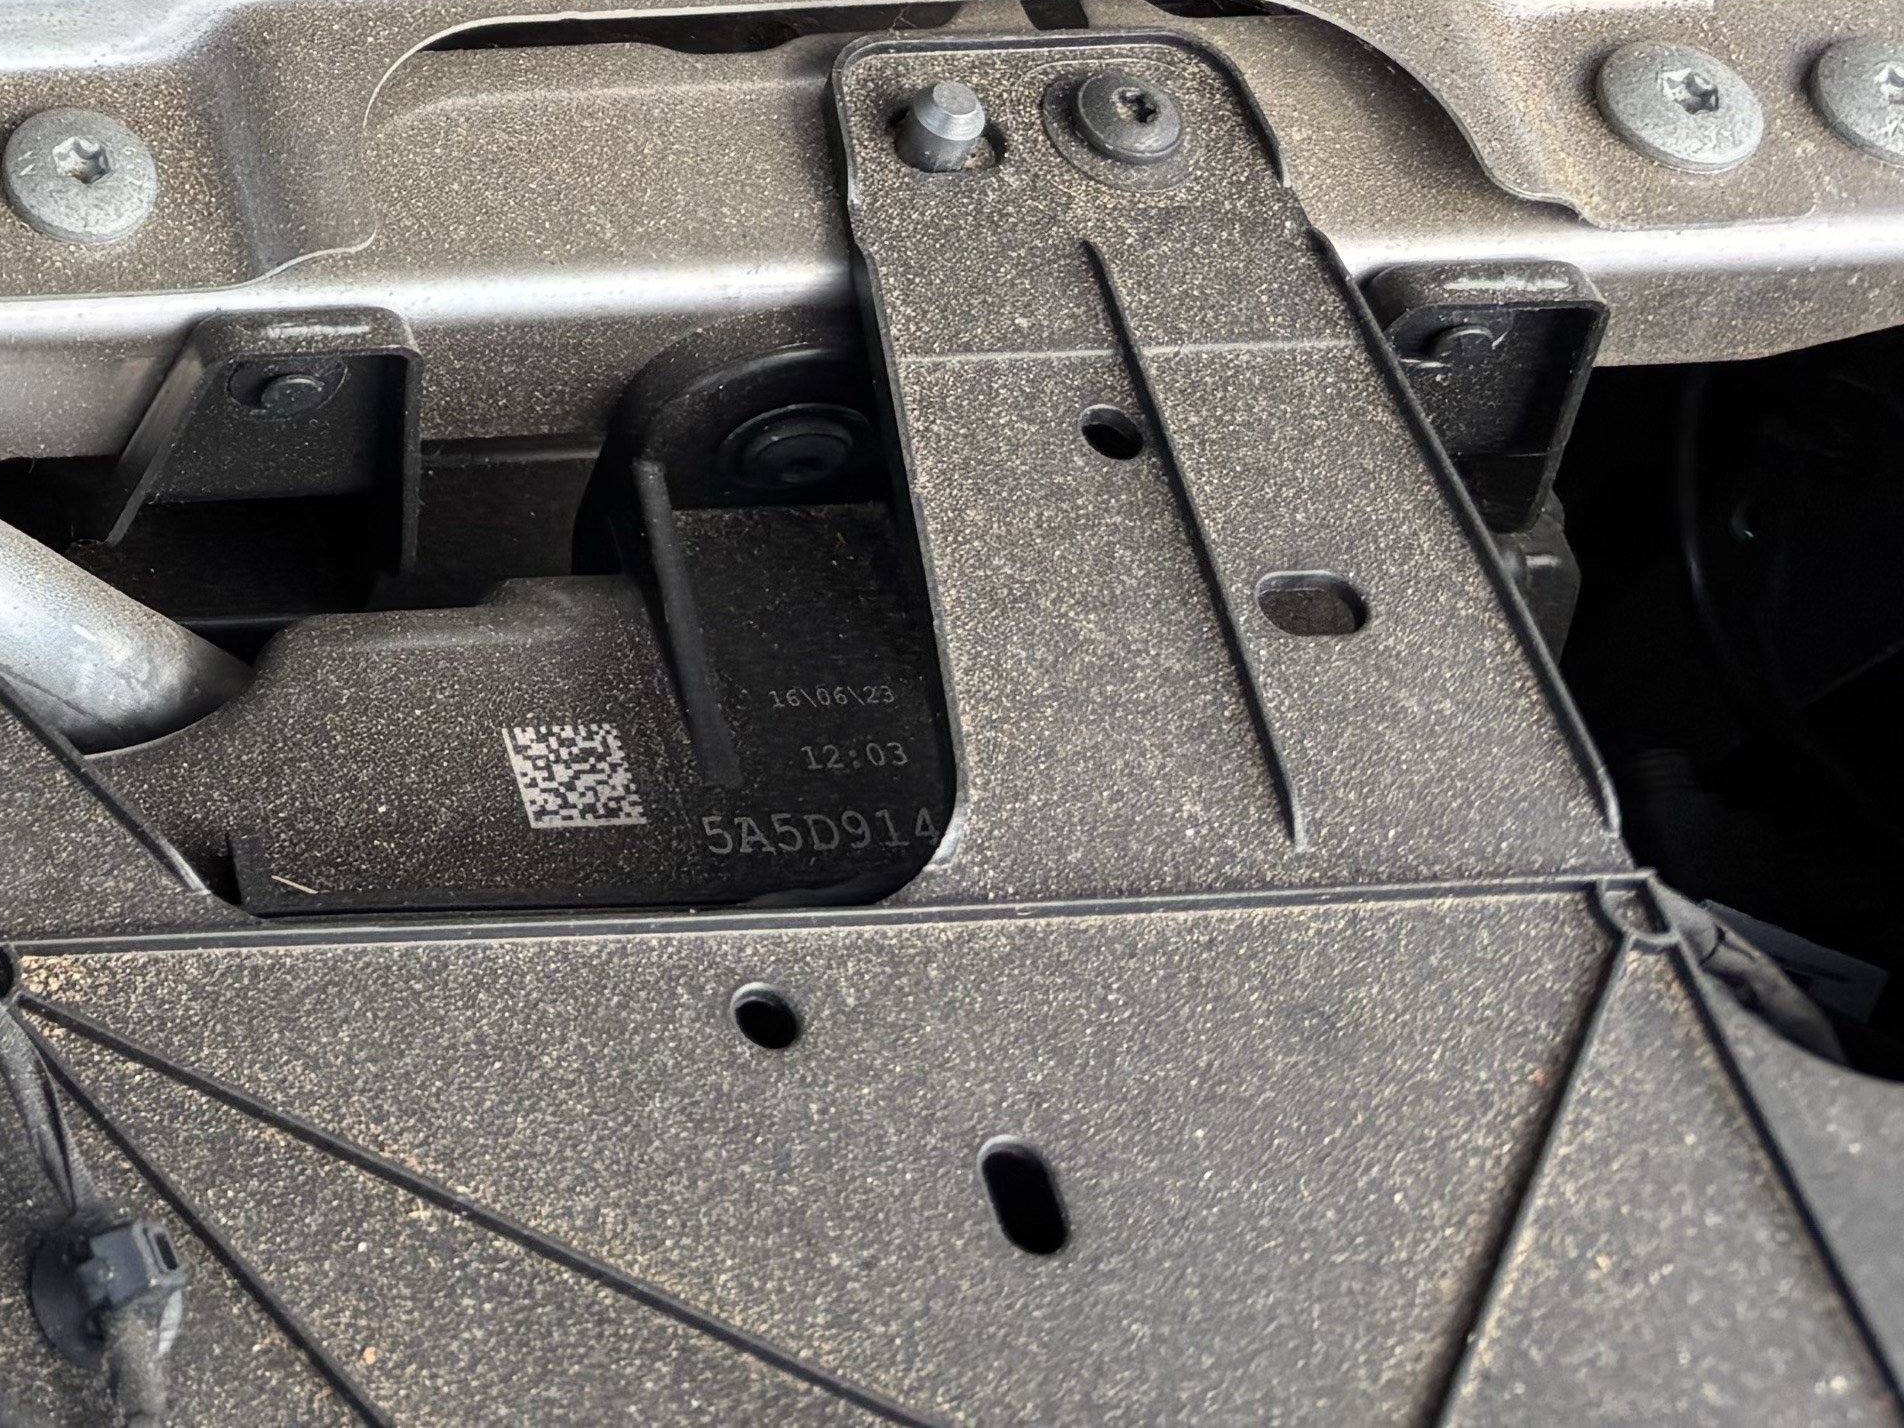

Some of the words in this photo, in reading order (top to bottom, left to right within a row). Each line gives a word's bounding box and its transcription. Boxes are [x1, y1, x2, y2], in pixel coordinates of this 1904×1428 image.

[768, 683, 896, 709] 16\06\23
[801, 741, 910, 771] 12:03
[700, 806, 942, 856] 5A5D914
